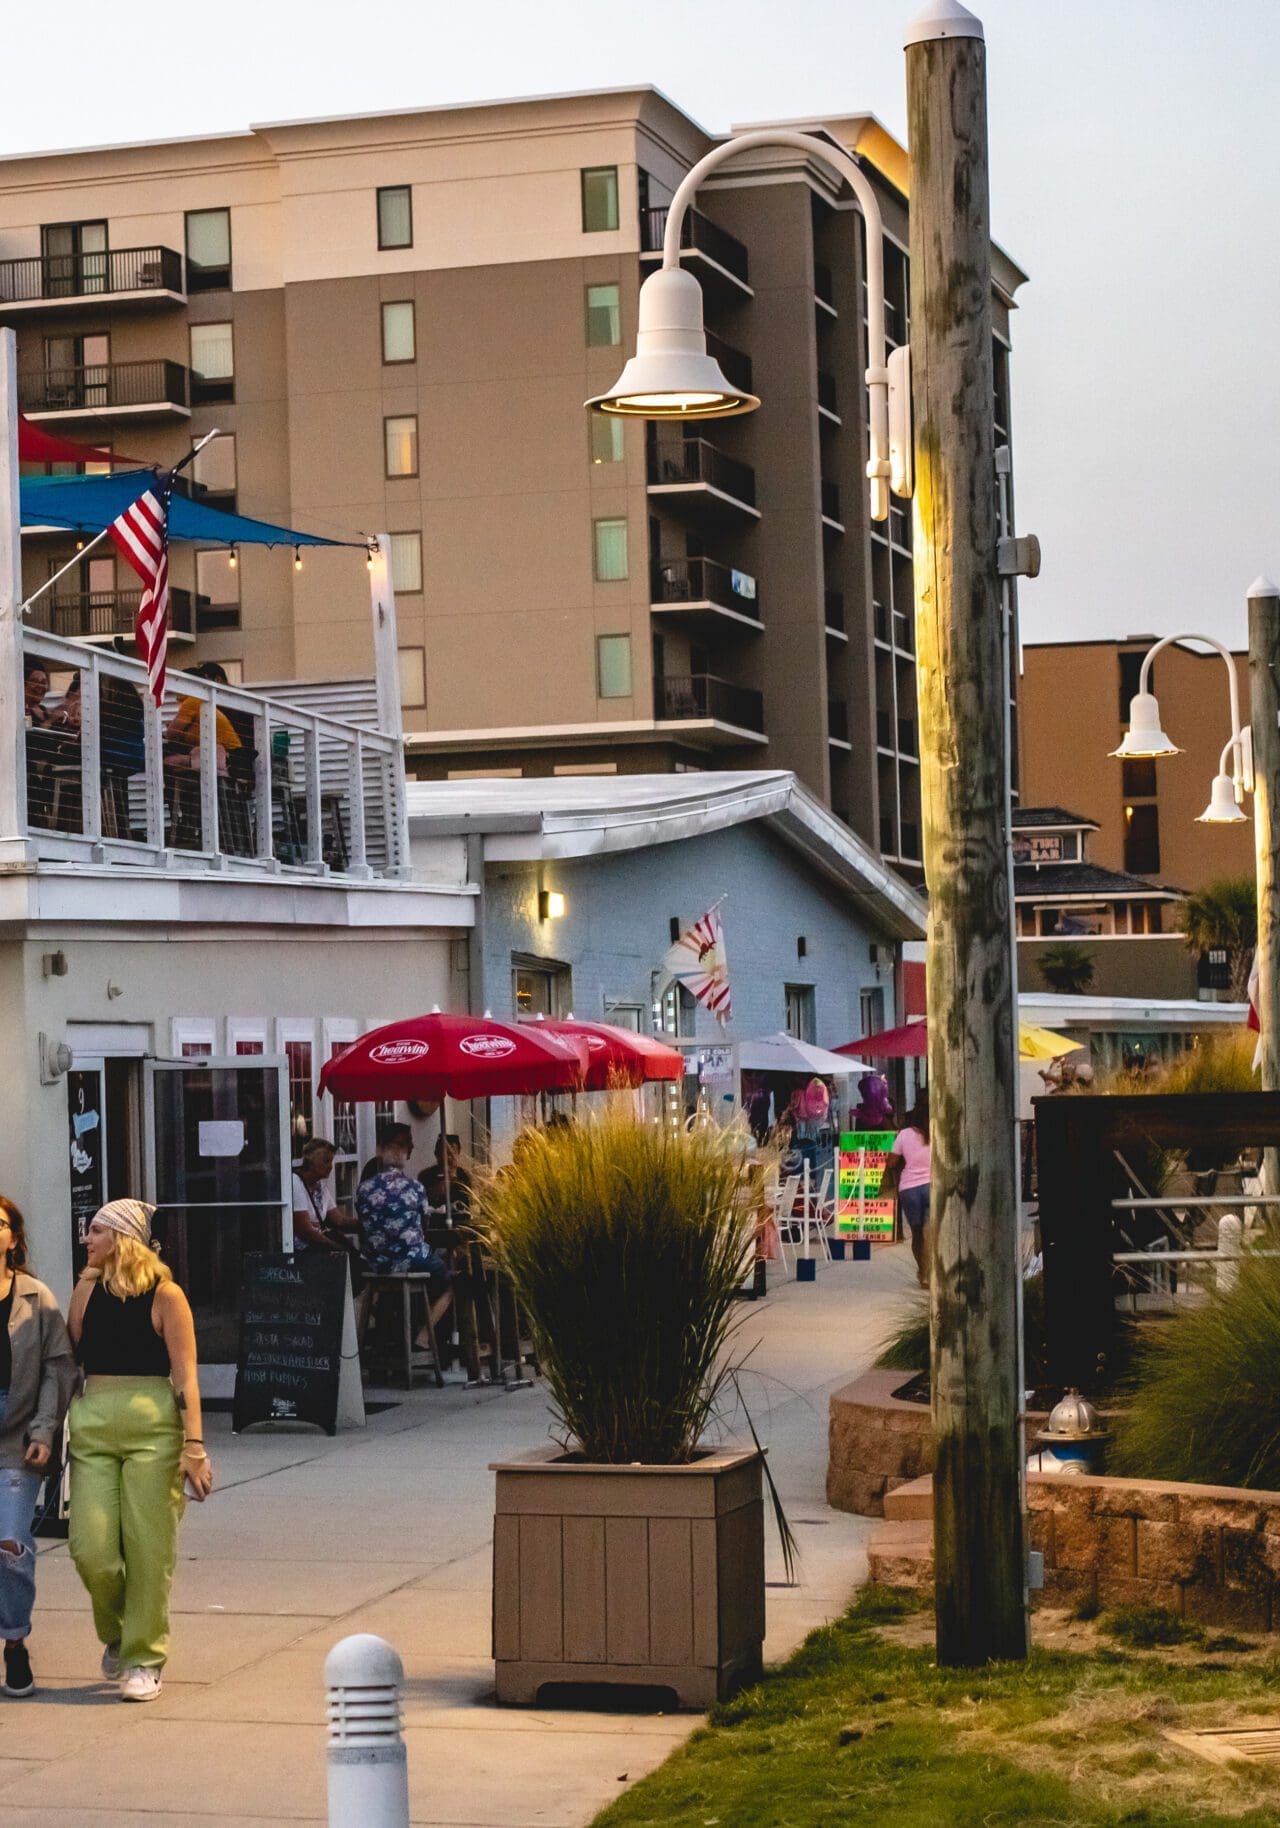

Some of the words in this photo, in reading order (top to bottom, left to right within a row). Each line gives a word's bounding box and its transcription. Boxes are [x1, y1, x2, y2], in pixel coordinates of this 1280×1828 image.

[1031, 838, 1060, 849] TIKI
[1031, 849, 1060, 861] BAR
[369, 1044, 428, 1057] Cheerwine
[260, 1267, 302, 1281] SPECIAL
